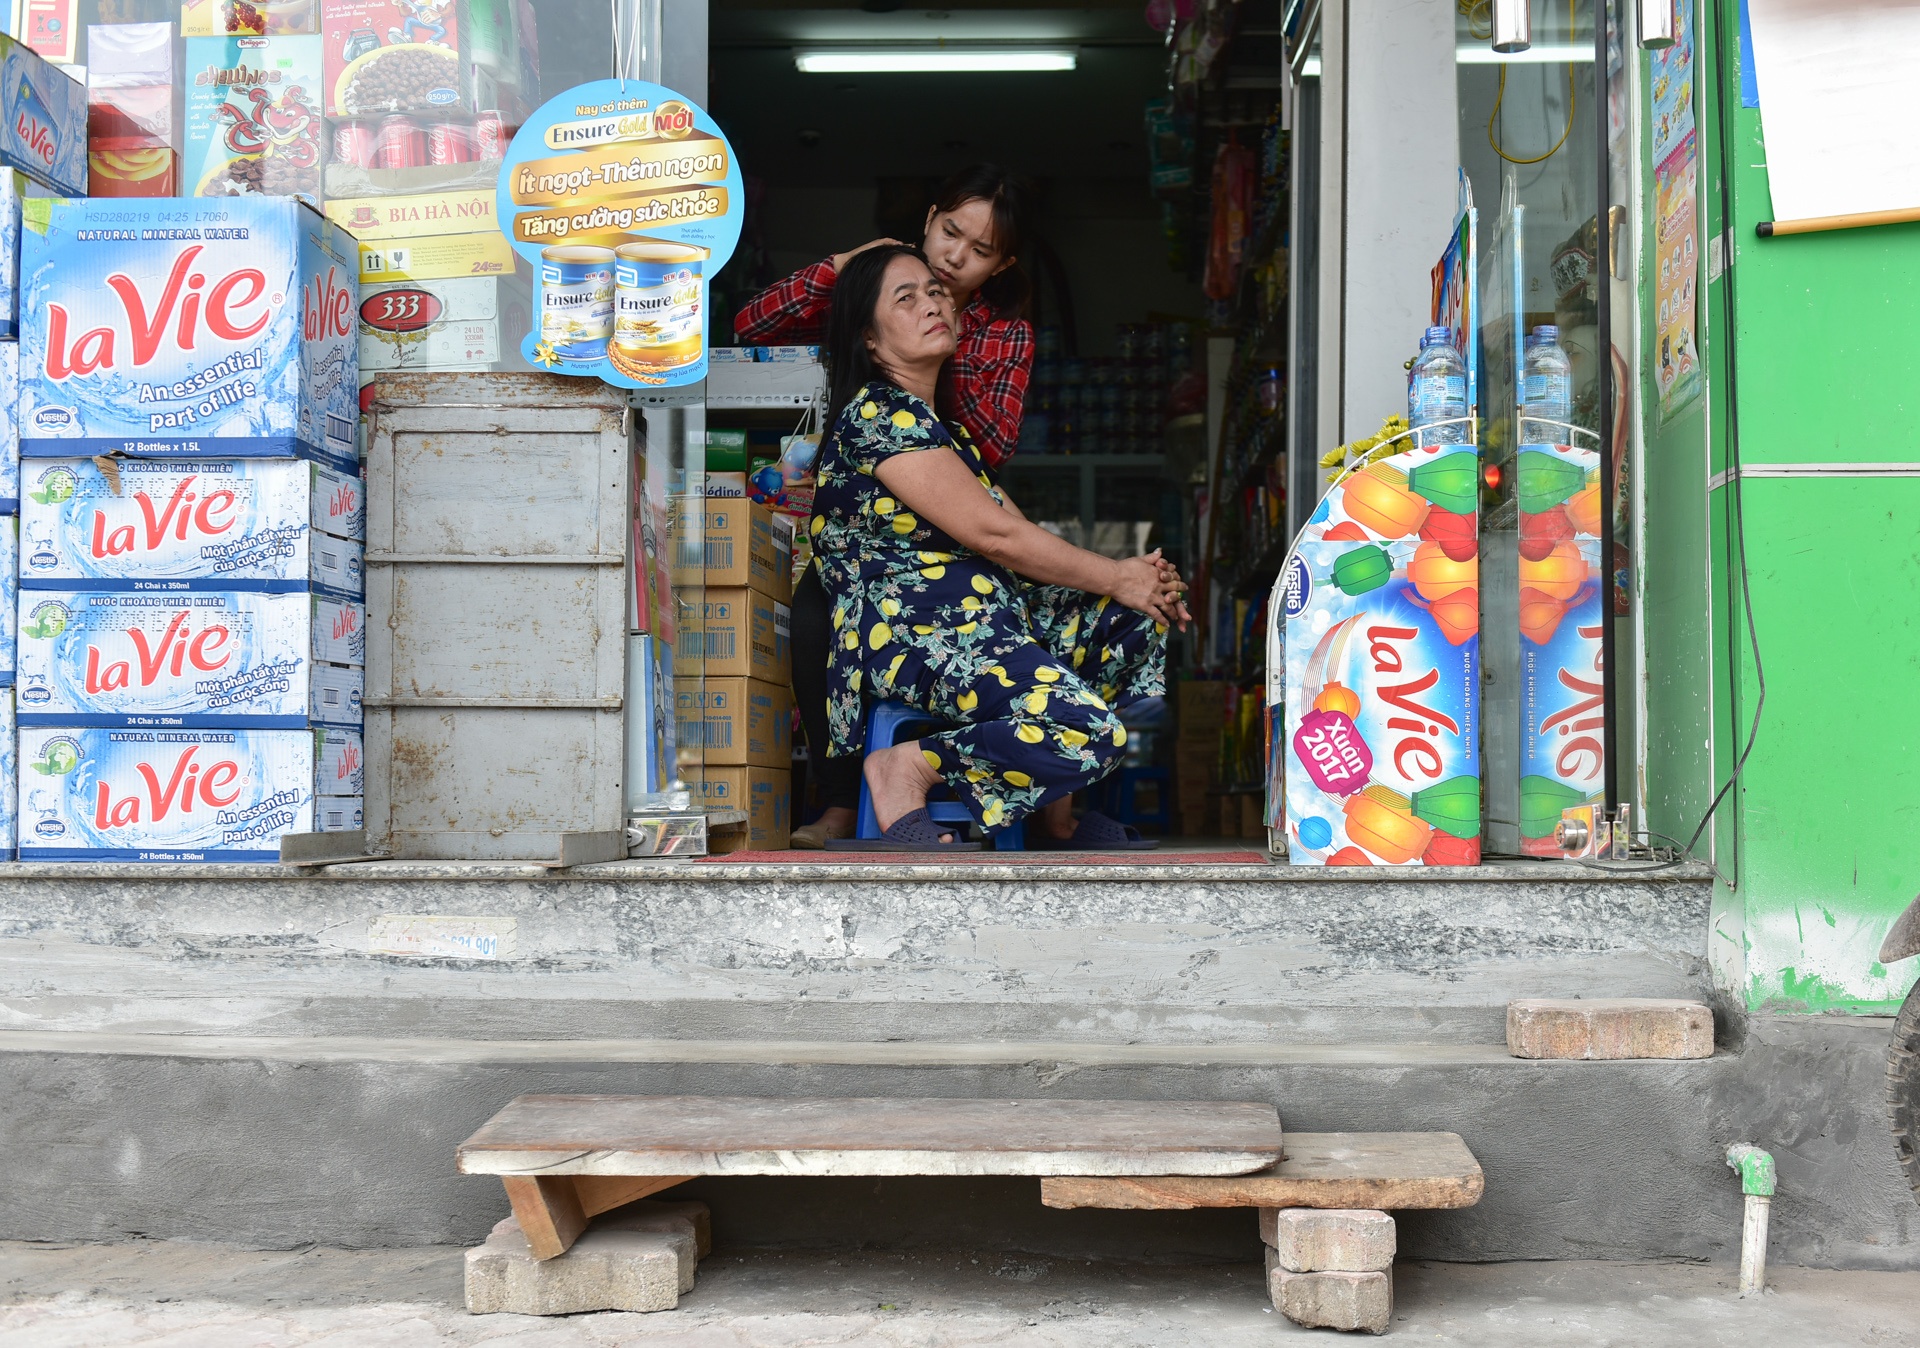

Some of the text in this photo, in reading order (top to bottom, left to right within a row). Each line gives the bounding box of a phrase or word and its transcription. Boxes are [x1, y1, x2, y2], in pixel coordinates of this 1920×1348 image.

[575, 98, 648, 117] Nay có thêm
[553, 108, 694, 143] Ensure Gold MỚI
[518, 167, 535, 194] Ít
[664, 153, 723, 179] ngon
[85, 211, 229, 223] HSD280219 04:25 L7060
[389, 197, 490, 223] BIA HÀ NỘI
[521, 190, 719, 237] Tăng cường sức khỏe
[77, 227, 249, 241] NATURAL MINERAL WATER
[471, 261, 489, 273] 24
[663, 273, 676, 282] NEW
[546, 292, 593, 307] Ensure
[620, 284, 698, 310] Ensure Gold
[377, 294, 420, 321] 333
[464, 326, 484, 334] 24 LON
[139, 347, 263, 404] An essential
[150, 380, 257, 433] part of life
[38, 411, 69, 423] Nestlé
[123, 441, 201, 452] 12 Bottles x 1.5L
[127, 462, 168, 473] KHOÁNG
[170, 462, 200, 473] THIÊN
[202, 462, 234, 473] NHIÊN
[694, 484, 741, 497] Bédine
[201, 524, 300, 560] Một phần tất yếu
[31, 555, 57, 565] Nestlé
[214, 540, 295, 573] của cuộc sống
[134, 581, 143, 589] 24
[144, 581, 161, 589] Chai
[168, 581, 190, 589] 350ml
[1287, 554, 1302, 611] Nestlé
[89, 596, 226, 607] NƯỚC KHOÁNG THIÊN NHIÊN
[196, 661, 295, 696] Một phần tất yếu
[24, 690, 49, 700] Nestlé
[208, 677, 289, 708] của cuộc sống
[127, 717, 136, 725] 24
[137, 717, 154, 725] Chai
[161, 717, 183, 725] 350ml
[110, 733, 236, 743] NATURAL MINERAL WATER
[1325, 718, 1365, 776] Xuân
[1302, 728, 1350, 784] 2017
[217, 788, 299, 825] An essential
[37, 823, 64, 832] Nestlé
[223, 811, 294, 845] part of life
[139, 853, 148, 861] 24
[148, 852, 175, 861] Bottles
[182, 852, 205, 861] 350ml
